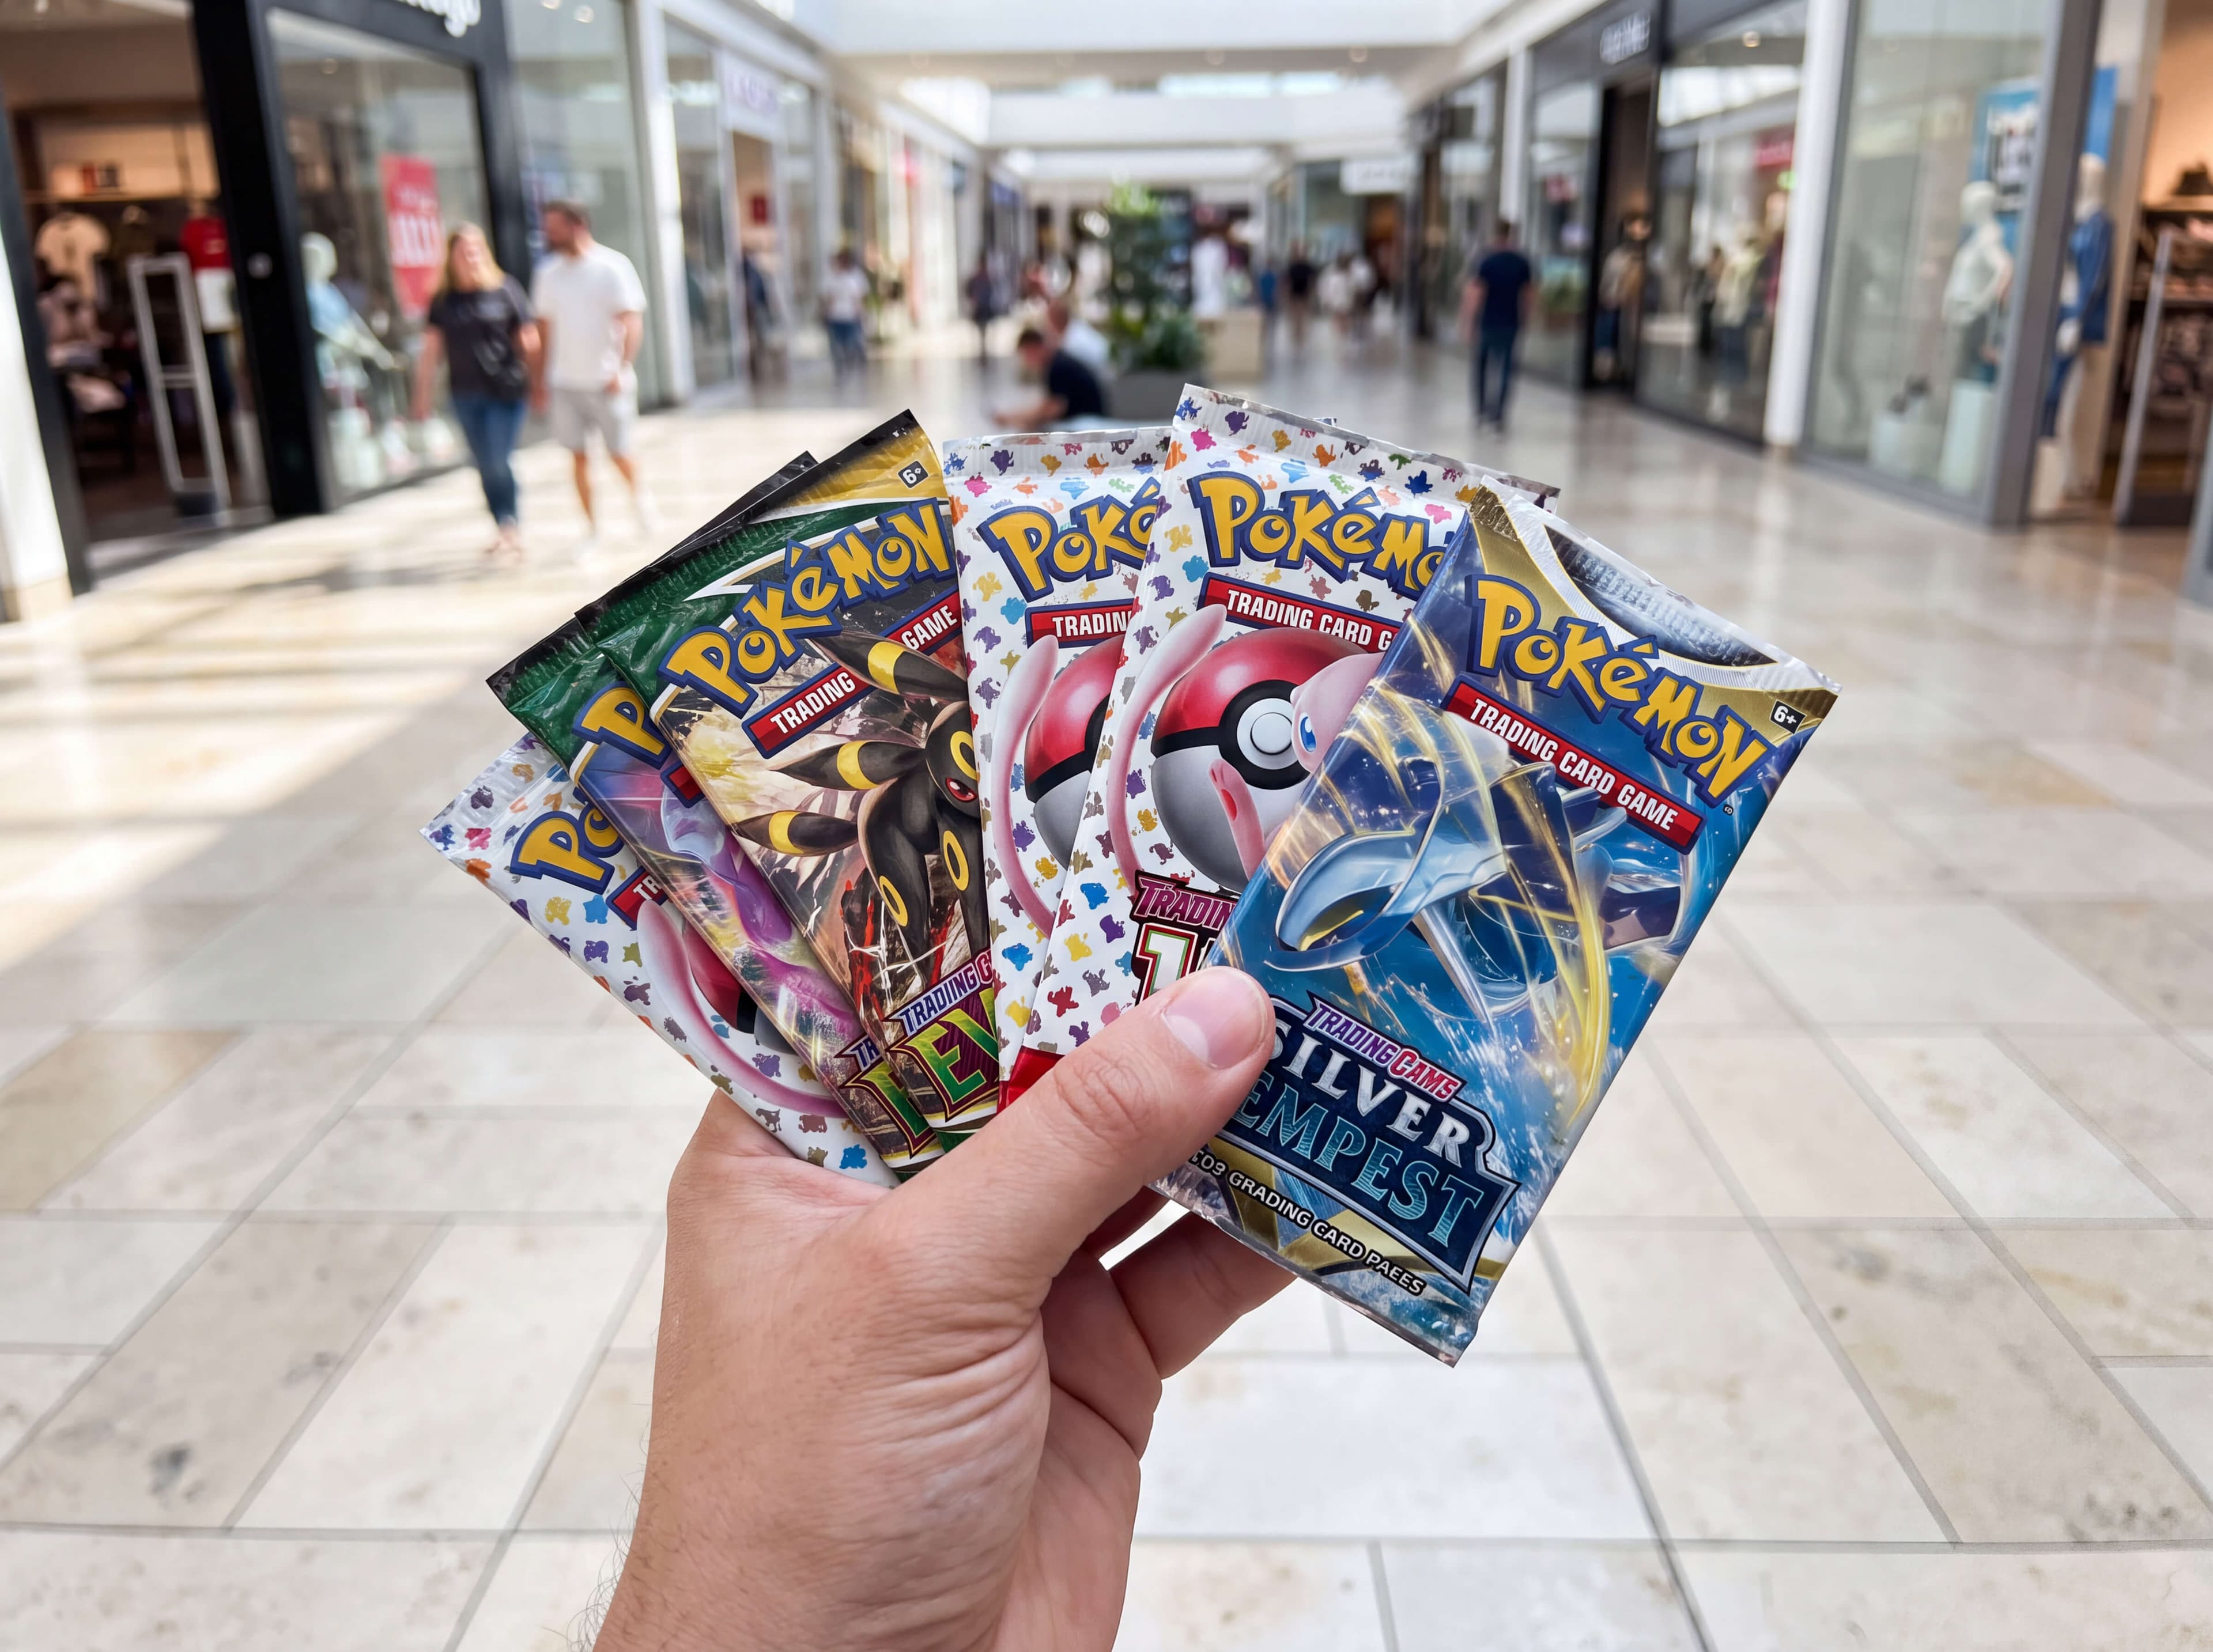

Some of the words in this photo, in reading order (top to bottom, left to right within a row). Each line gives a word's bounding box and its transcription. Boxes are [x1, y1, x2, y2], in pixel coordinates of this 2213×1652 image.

[976, 477, 1161, 603] POKé
[1187, 471, 1449, 602] POKéMO
[1052, 611, 1132, 637] TRADIN
[1227, 589, 1313, 629] TRADING
[1319, 615, 1372, 646] CARD
[771, 671, 856, 734] TRADING
[901, 605, 958, 651] GAME
[1774, 705, 1797, 724] 6+
[1470, 699, 1559, 762] TRADING
[1559, 751, 1616, 795] CARD
[1617, 784, 1679, 830] GAME
[1133, 877, 1237, 931] TRADIN
[1308, 1004, 1398, 1064] TRADING
[1268, 1021, 1470, 1169] SILVER
[1229, 1172, 1311, 1226] GRADING
[1232, 1071, 1485, 1248] EMPEST
